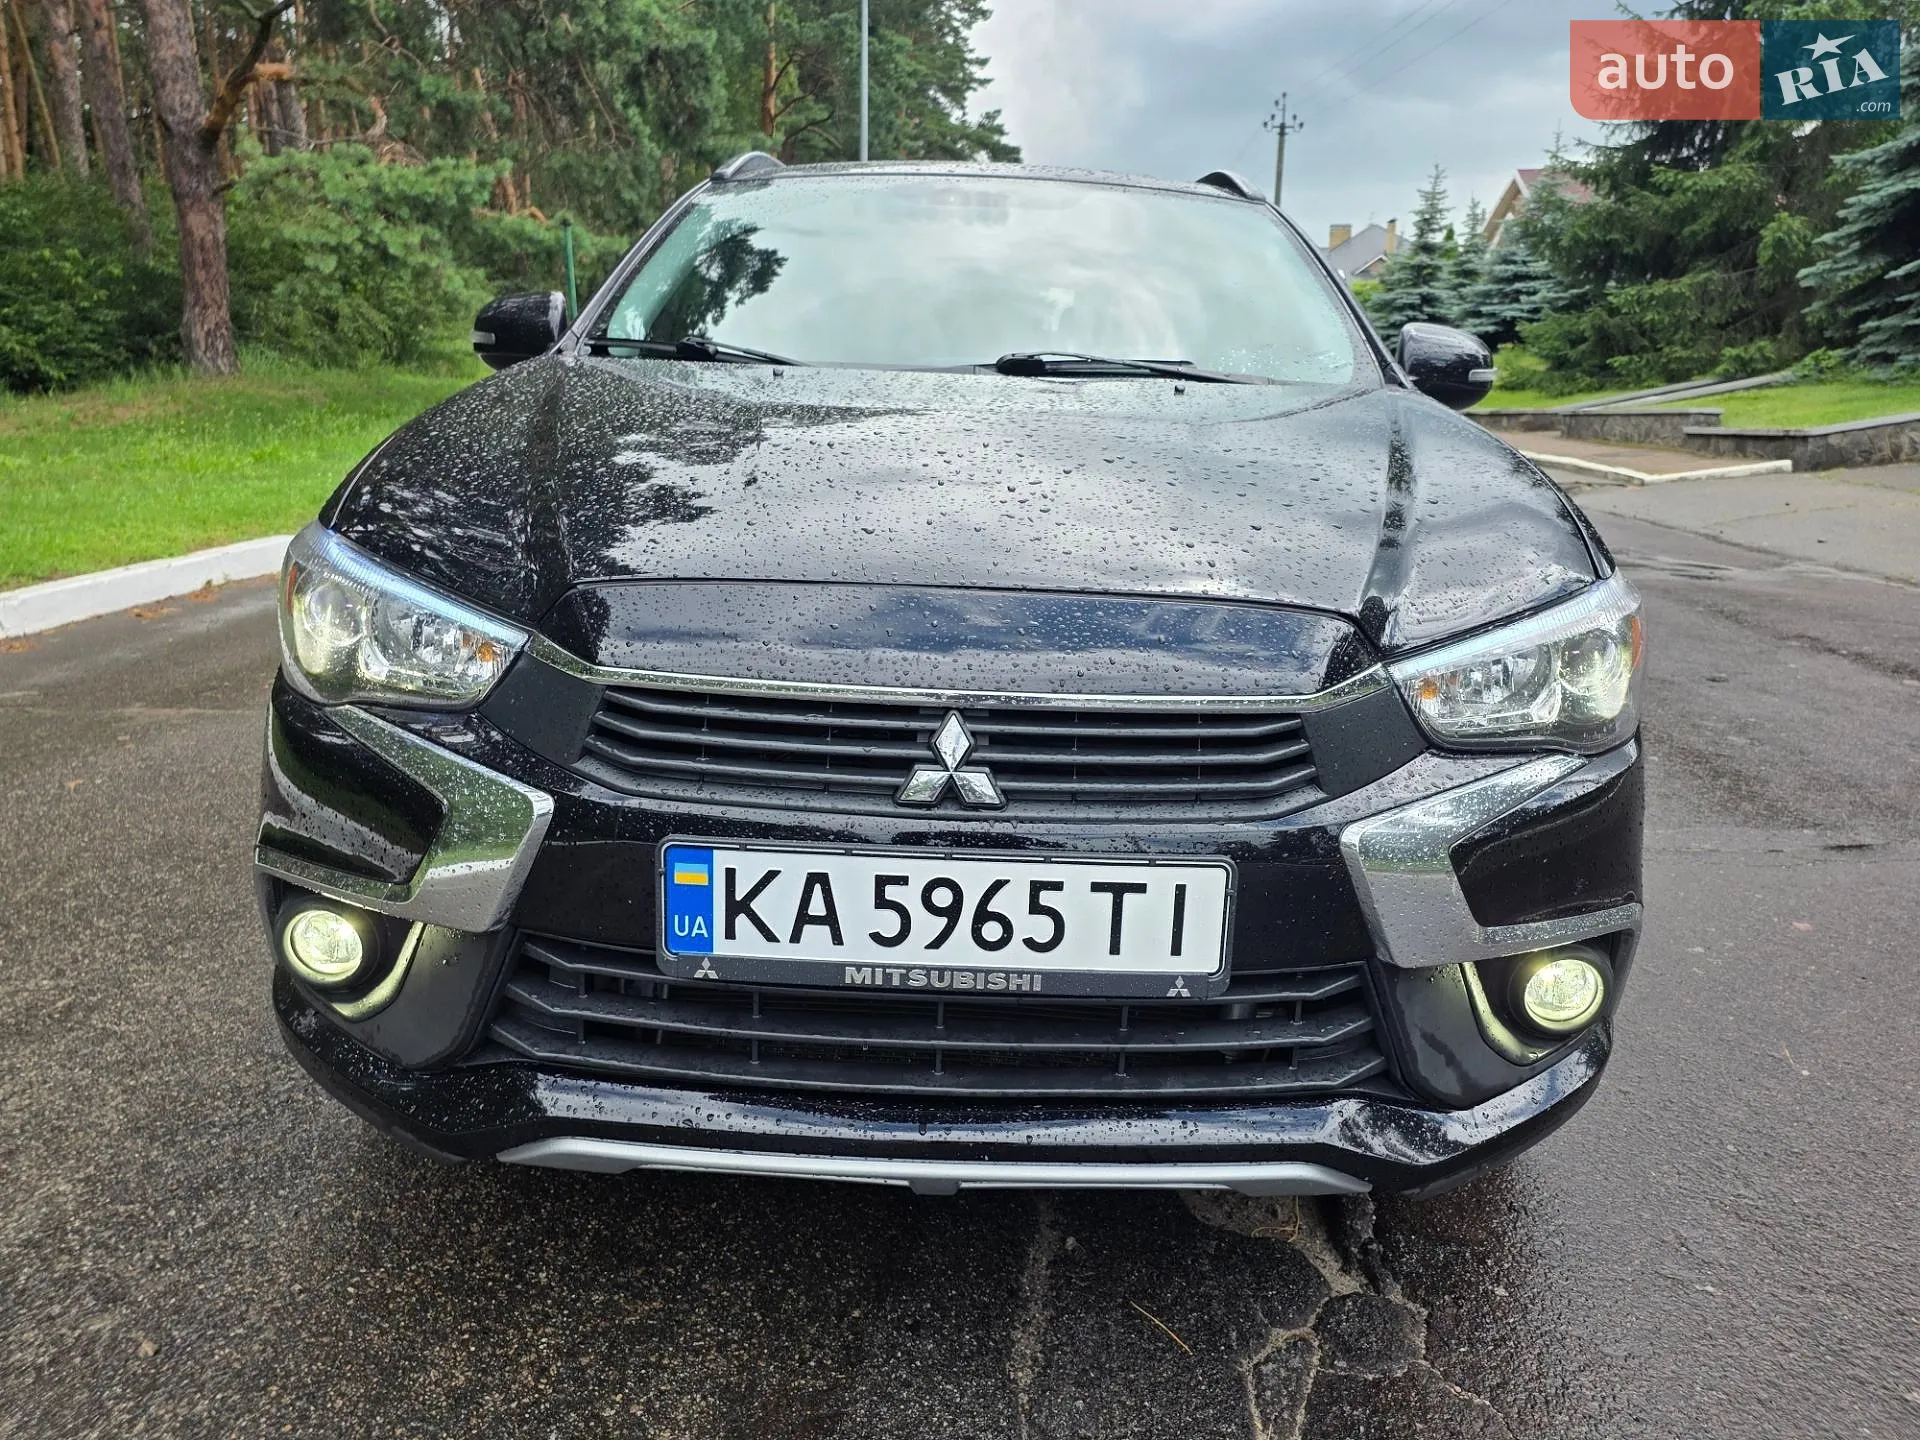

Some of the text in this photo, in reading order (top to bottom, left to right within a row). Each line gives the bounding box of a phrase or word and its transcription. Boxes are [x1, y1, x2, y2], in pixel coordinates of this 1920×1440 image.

[723, 866, 1187, 957] KA 5965 TI
[673, 914, 709, 939] UA
[844, 966, 1043, 993] MITSUBISHI
